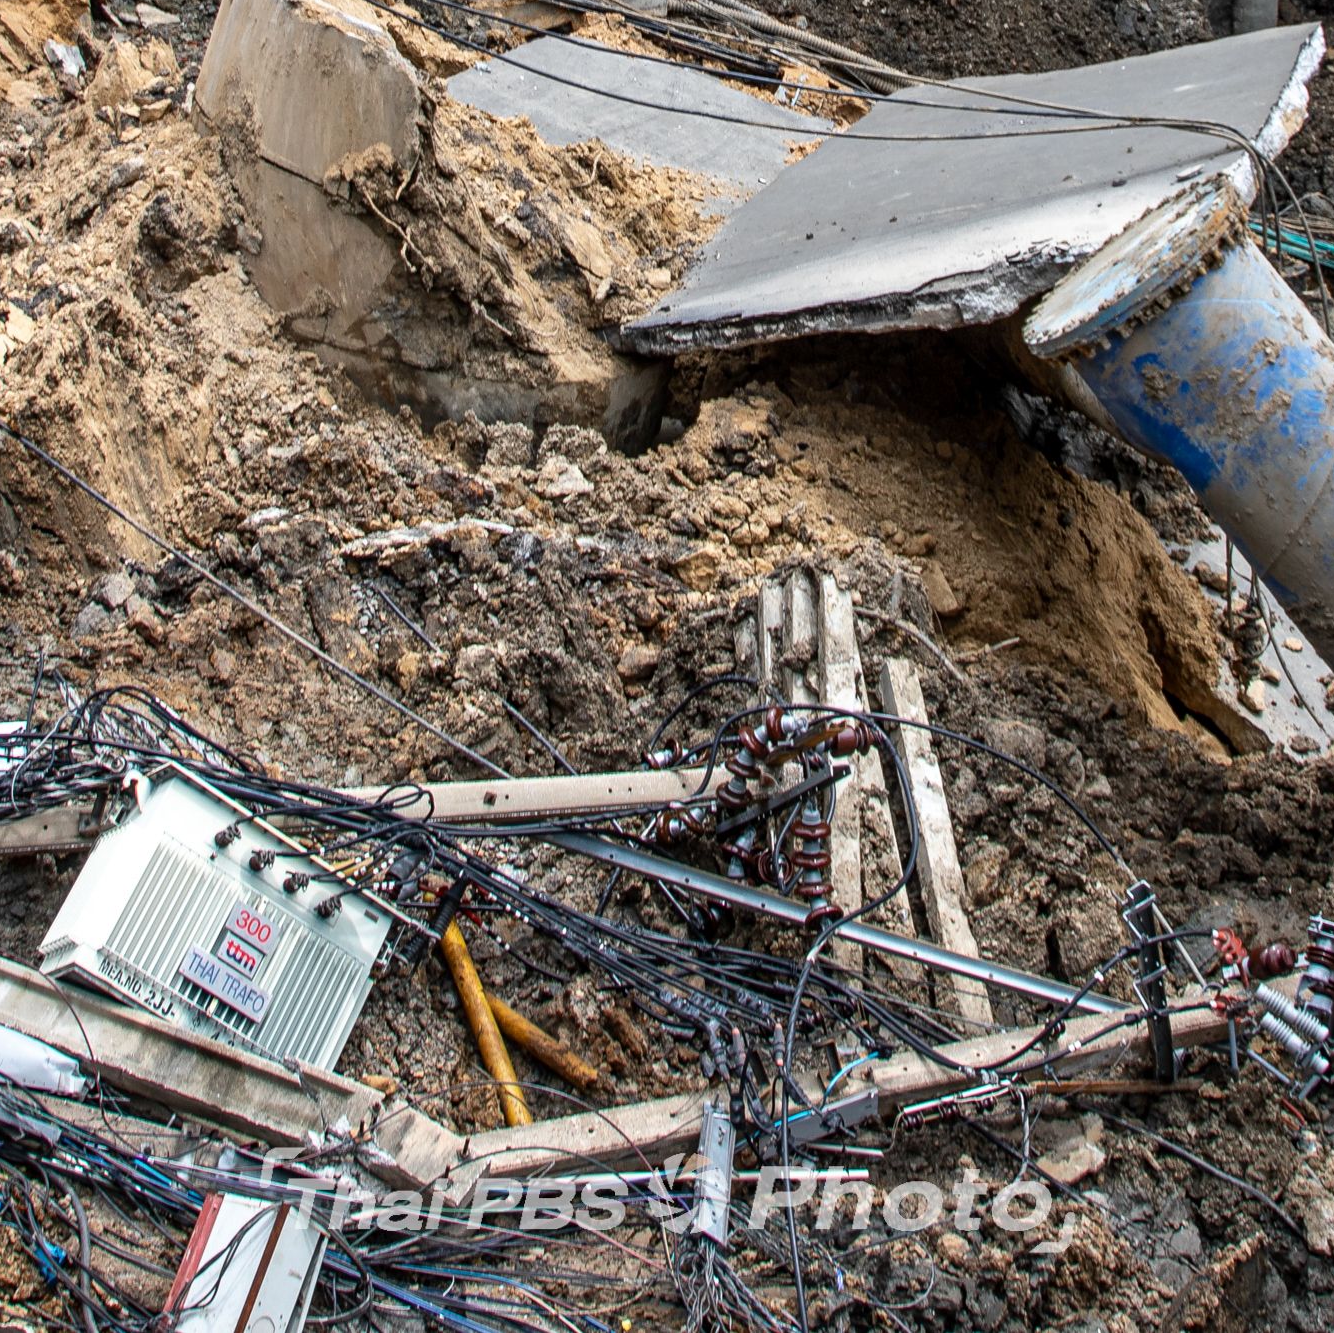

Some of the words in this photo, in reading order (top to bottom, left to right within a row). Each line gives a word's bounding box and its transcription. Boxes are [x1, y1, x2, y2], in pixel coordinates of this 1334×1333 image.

[236, 909, 271, 943] 300
[188, 951, 220, 985] THAI
[222, 972, 265, 1013] TRAFO
